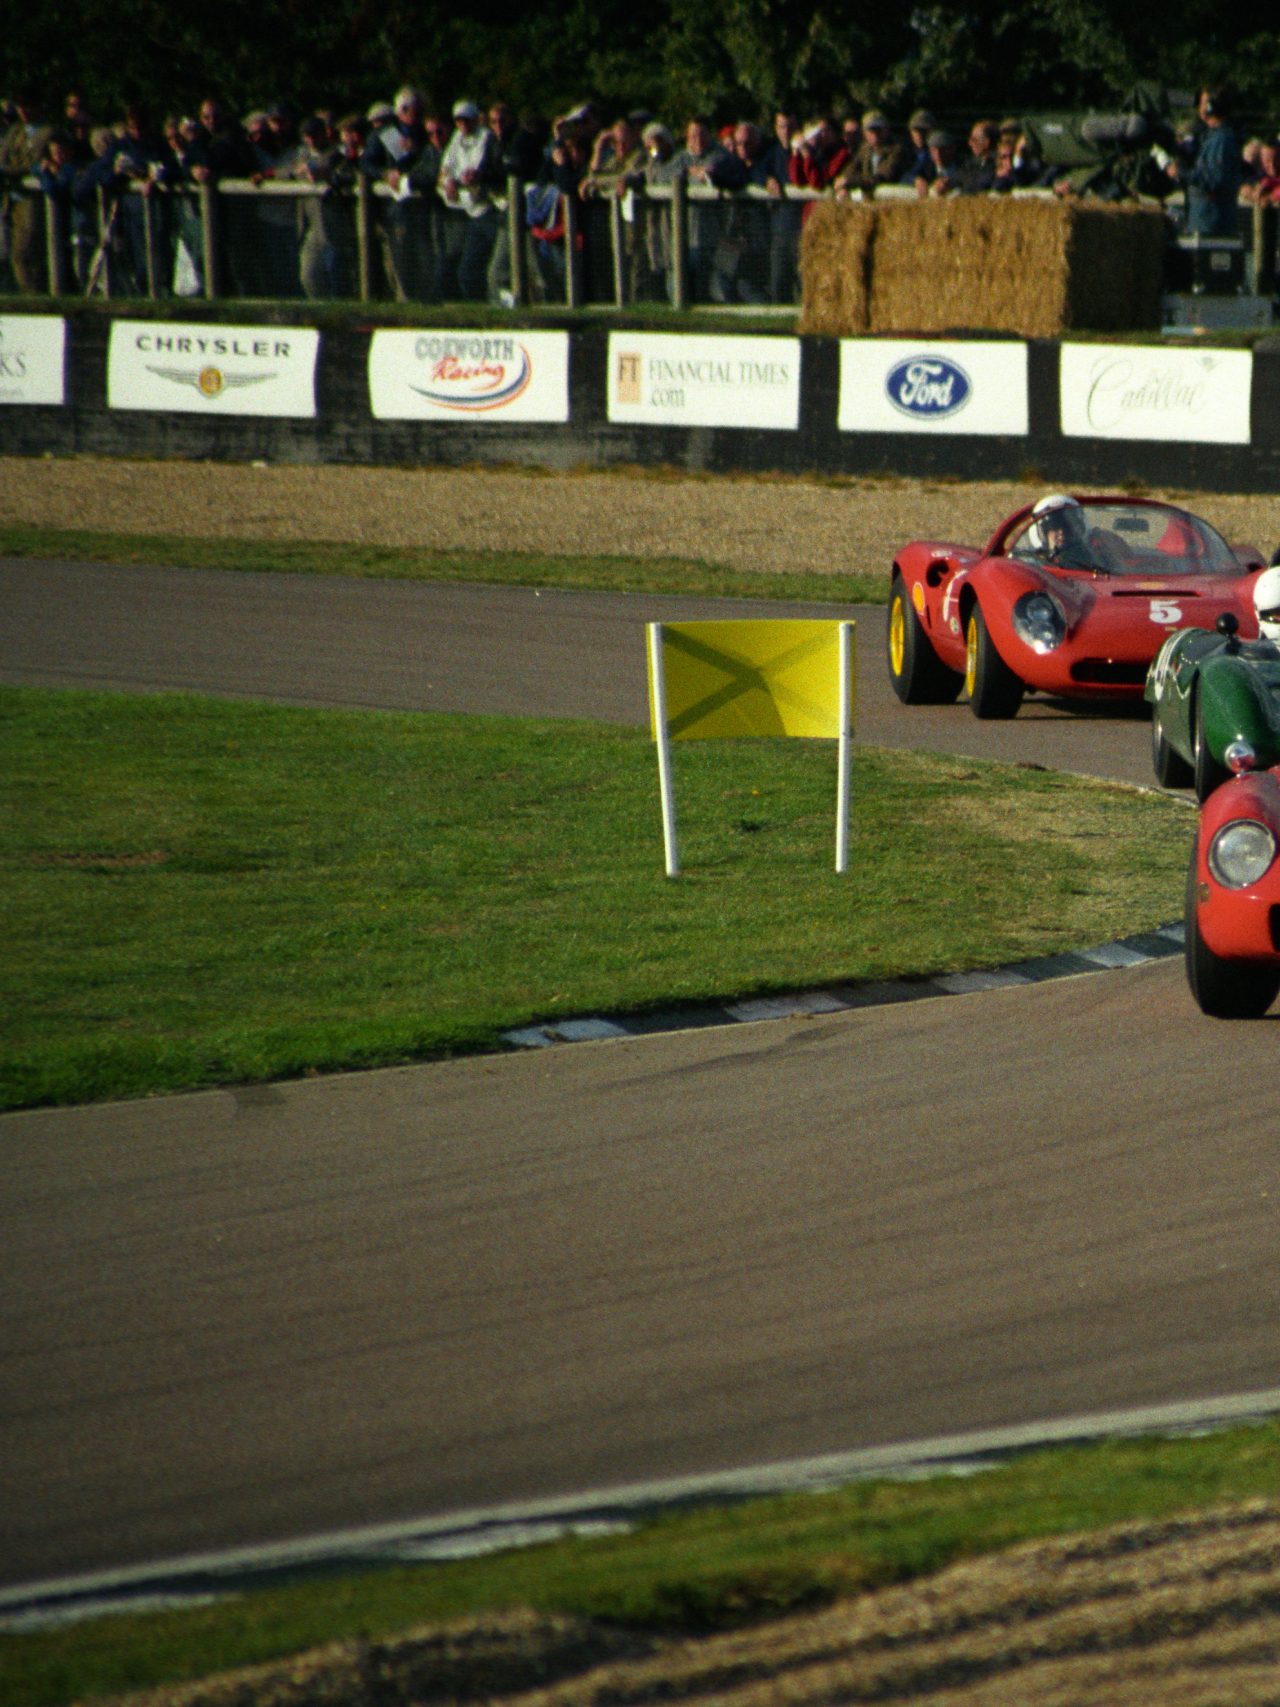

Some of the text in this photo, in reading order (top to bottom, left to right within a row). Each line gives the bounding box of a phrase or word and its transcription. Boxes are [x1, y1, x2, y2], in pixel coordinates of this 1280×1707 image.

[136, 335, 291, 358] CHRYSLER
[649, 358, 790, 385] FINANCIAL TIMES
[900, 361, 955, 407] Ford
[1087, 353, 1208, 431] Cadillac
[1149, 599, 1183, 624] 5
